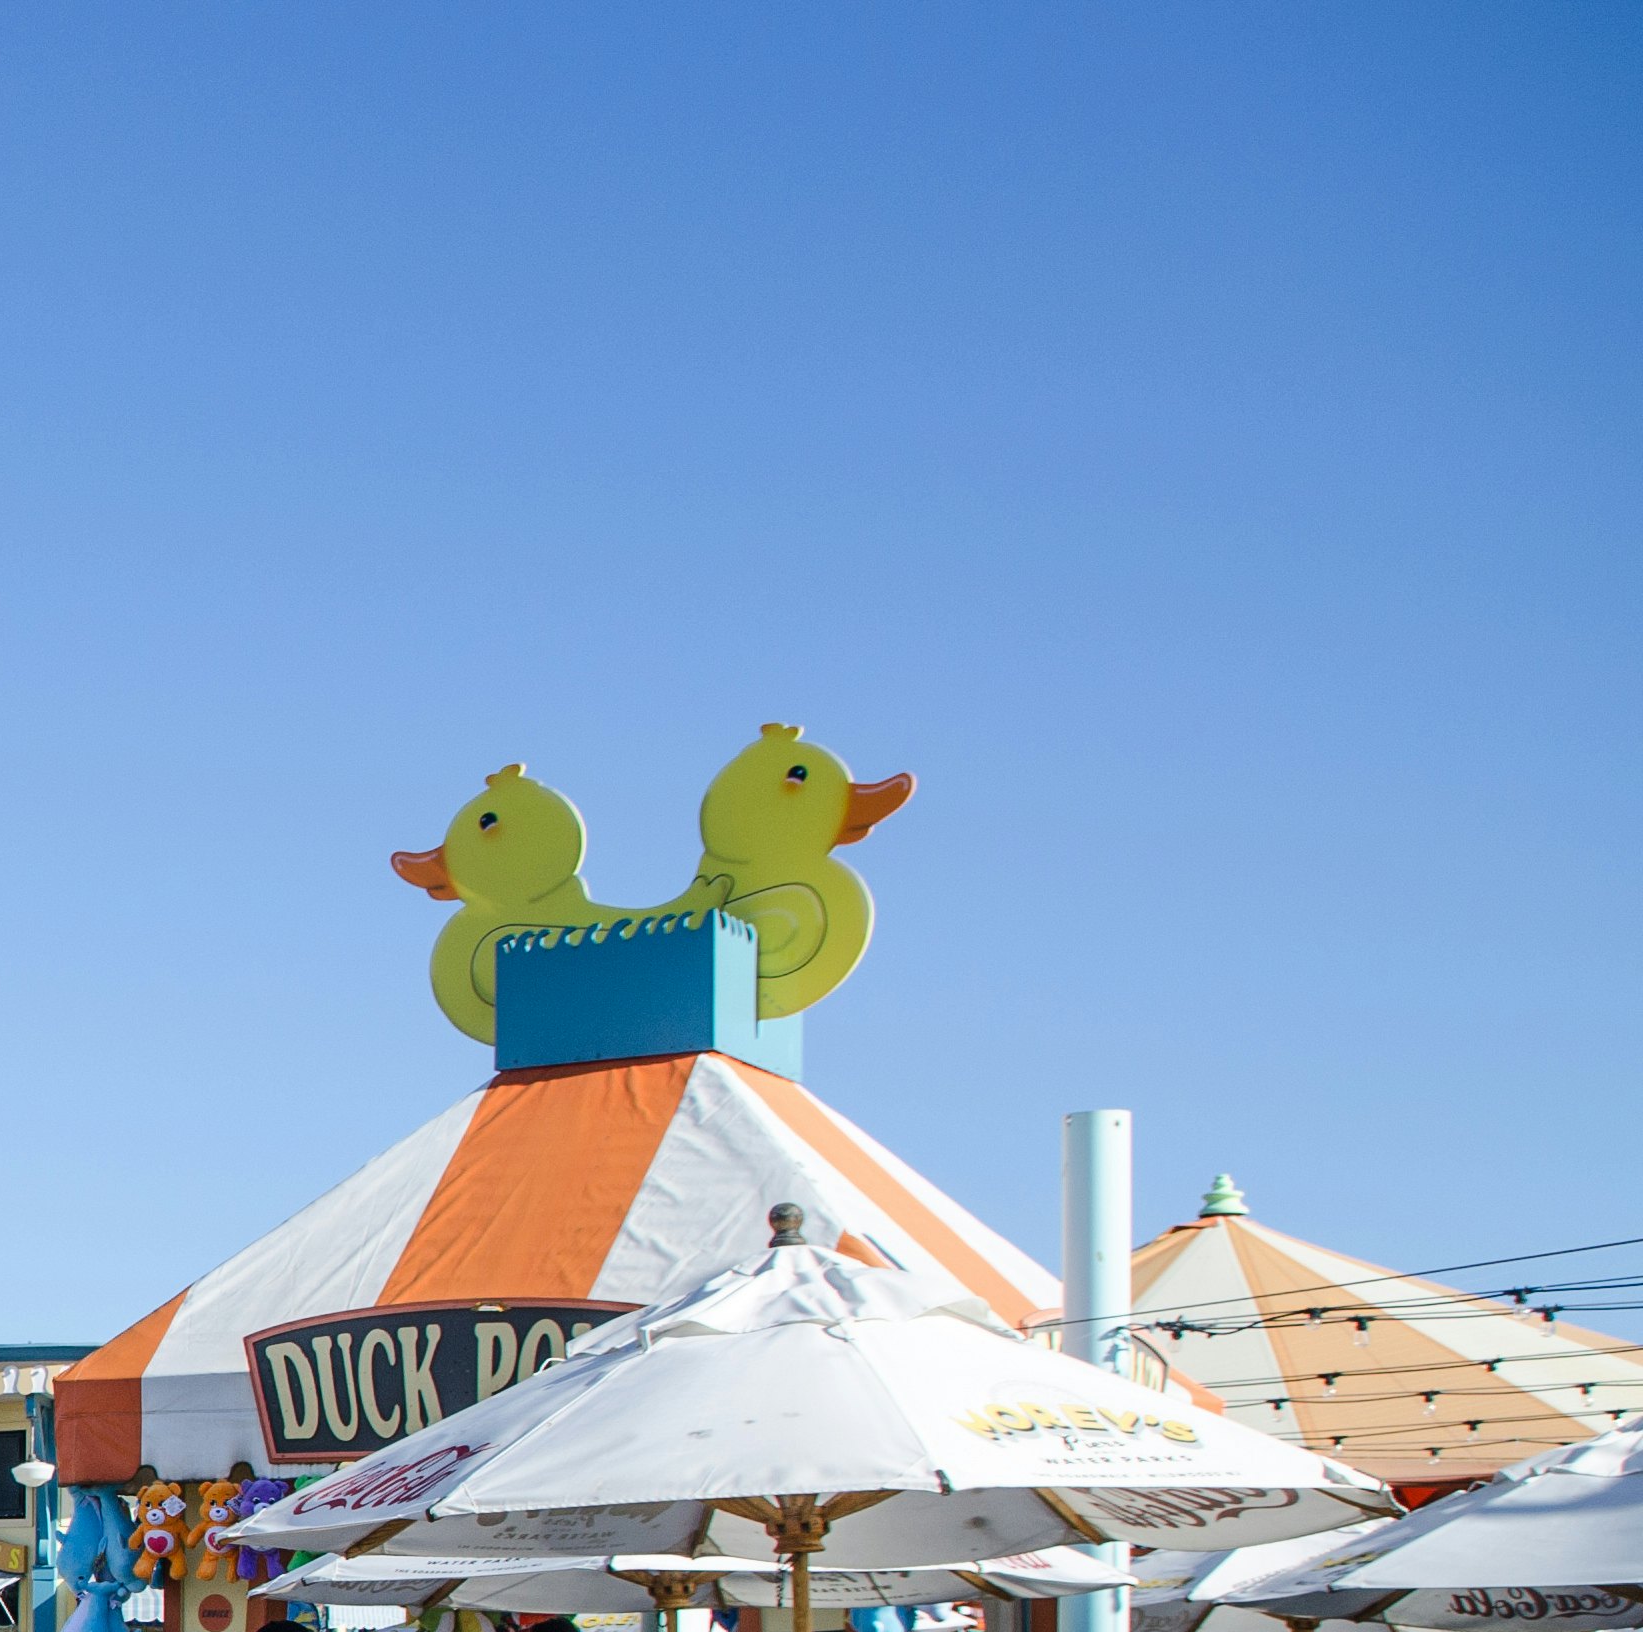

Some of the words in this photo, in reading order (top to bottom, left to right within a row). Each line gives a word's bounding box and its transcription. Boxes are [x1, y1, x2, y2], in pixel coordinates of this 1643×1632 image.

[265, 1323, 446, 1442] DUCK
[475, 1318, 592, 1401] PO
[949, 1402, 1202, 1446] MOREY'S
[1042, 1456, 1113, 1466] WATER
[1120, 1454, 1194, 1463] PARKS
[427, 1559, 478, 1567] WATER
[483, 1556, 531, 1564] PARK
